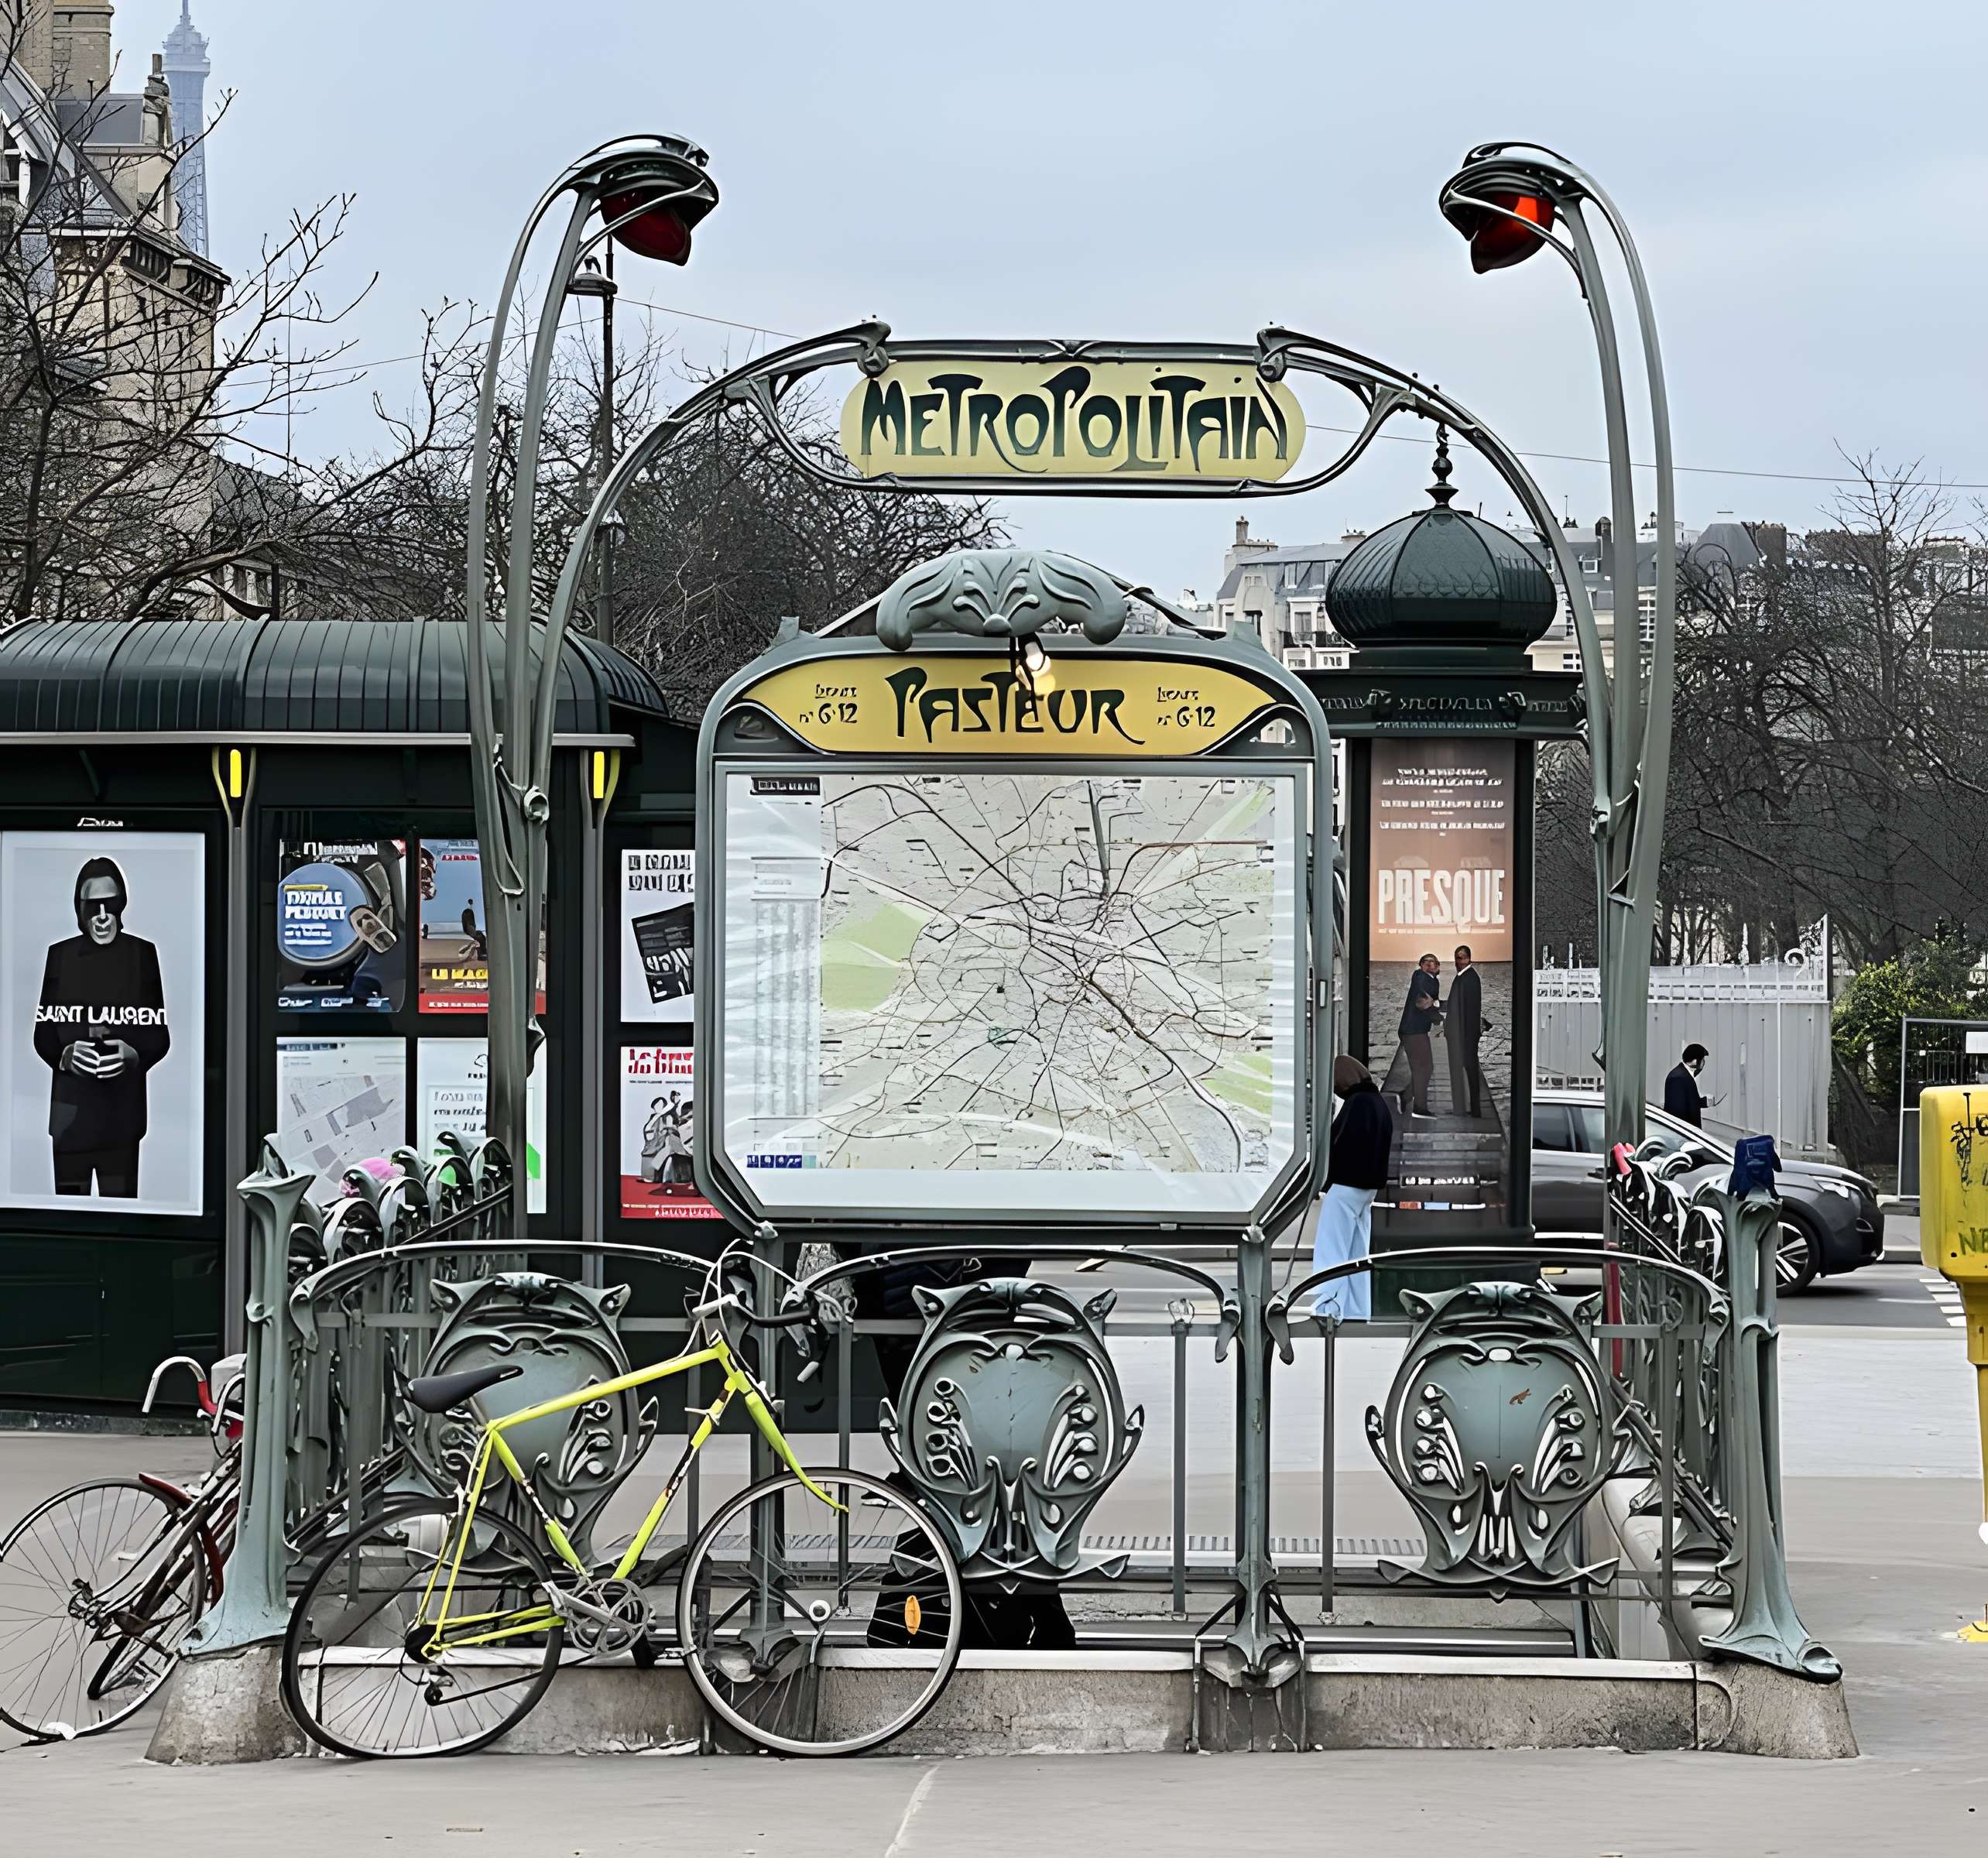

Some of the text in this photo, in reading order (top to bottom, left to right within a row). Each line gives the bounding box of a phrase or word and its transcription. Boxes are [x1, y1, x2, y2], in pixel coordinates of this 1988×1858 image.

[861, 365, 1287, 473] METROPOLITAIN
[885, 667, 1145, 744] PASTEUR
[1379, 869, 1505, 933] PRESQUE
[36, 1006, 167, 1026] SAINT LAURENT
